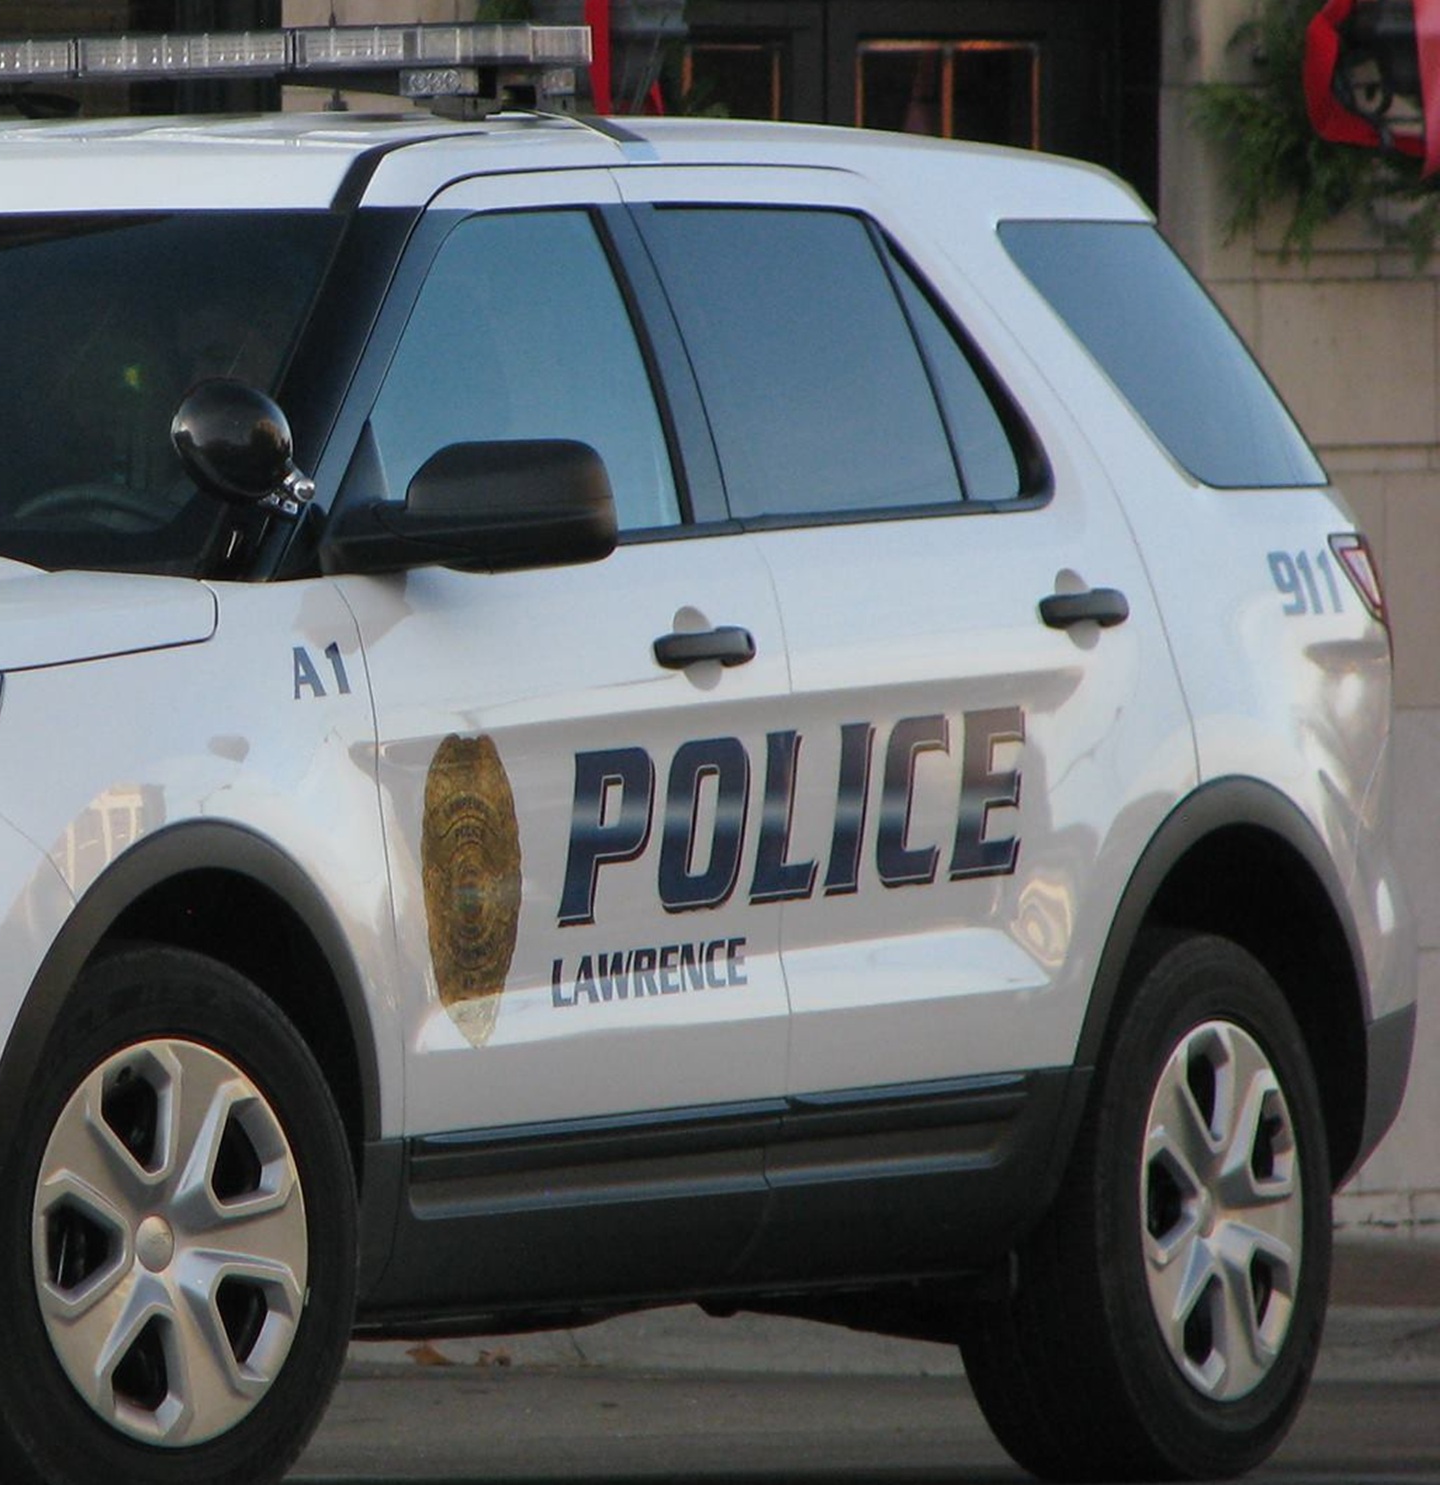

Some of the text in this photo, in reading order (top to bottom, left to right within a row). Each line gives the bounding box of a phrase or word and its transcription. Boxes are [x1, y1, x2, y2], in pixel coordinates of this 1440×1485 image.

[1266, 550, 1344, 616] 911
[292, 641, 351, 700] A1
[557, 705, 1026, 928] POLICE
[551, 937, 748, 1007] LAWRENCE
